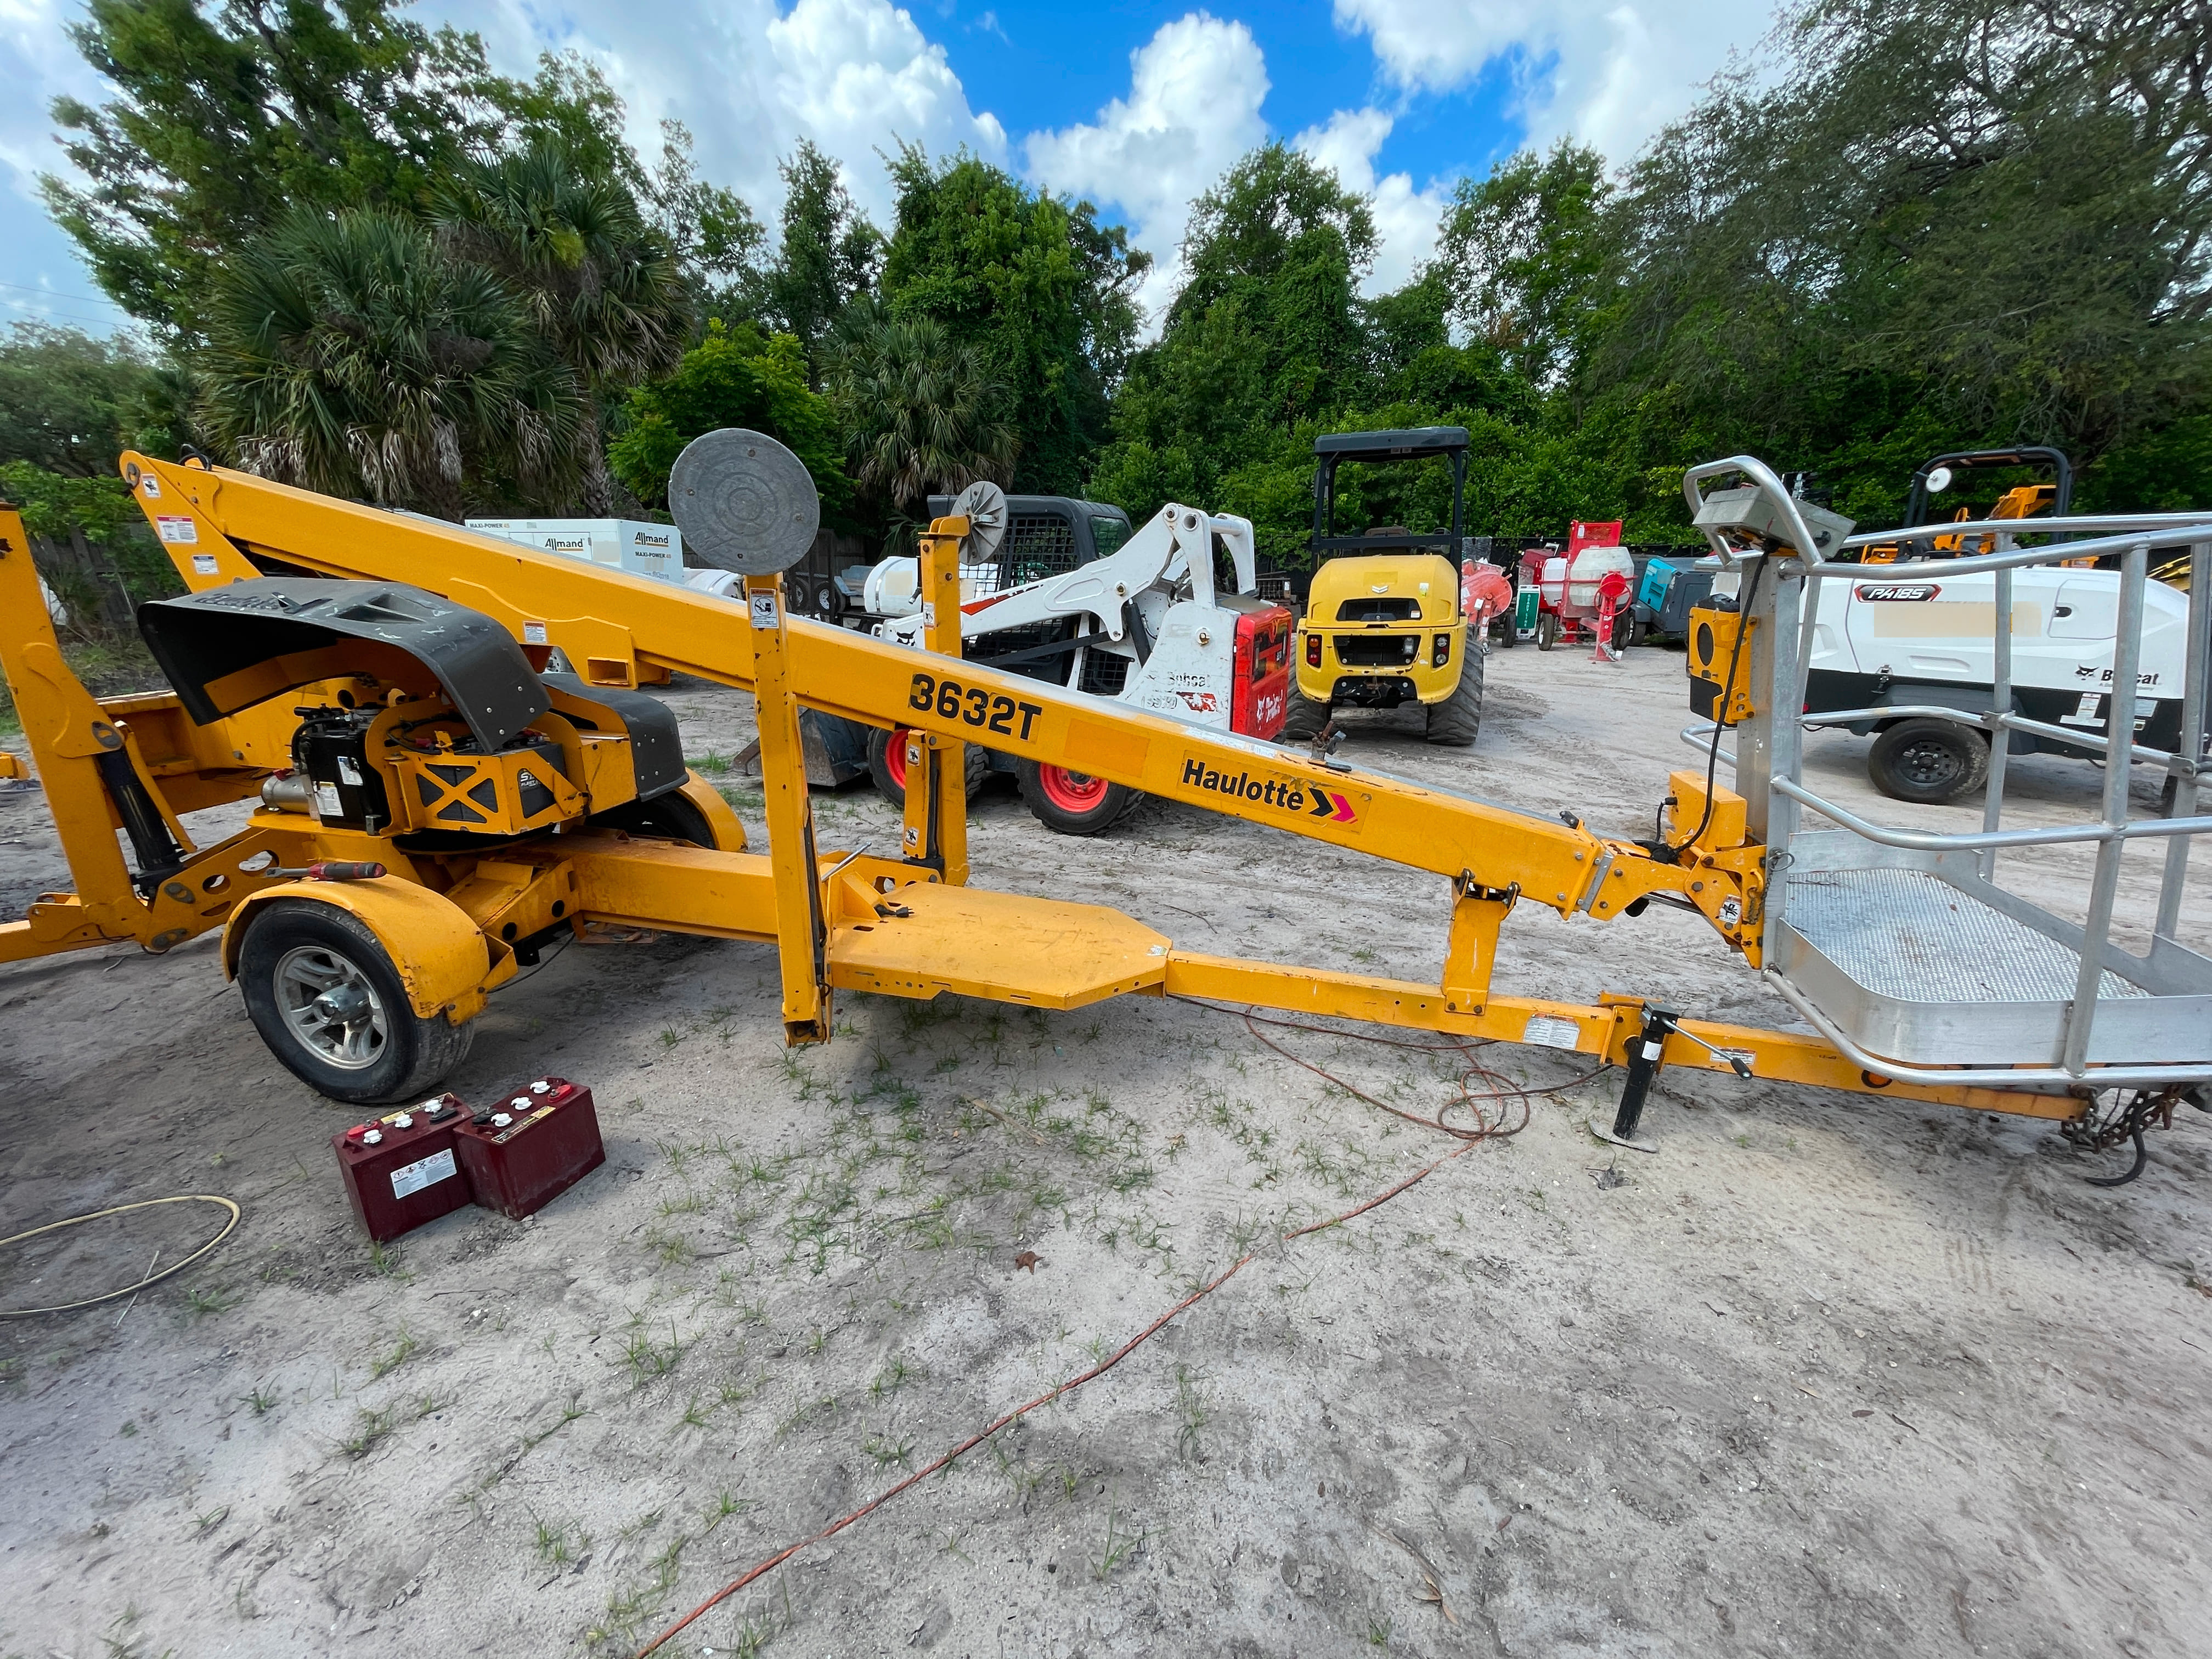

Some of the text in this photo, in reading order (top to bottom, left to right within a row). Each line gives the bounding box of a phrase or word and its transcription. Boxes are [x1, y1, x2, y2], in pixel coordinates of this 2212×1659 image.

[545, 538, 583, 551] Allmand
[635, 532, 669, 545] Allmand
[1867, 588, 1927, 599] PA185
[910, 673, 1042, 741] 3632T
[1182, 759, 1304, 810] Haulotte
